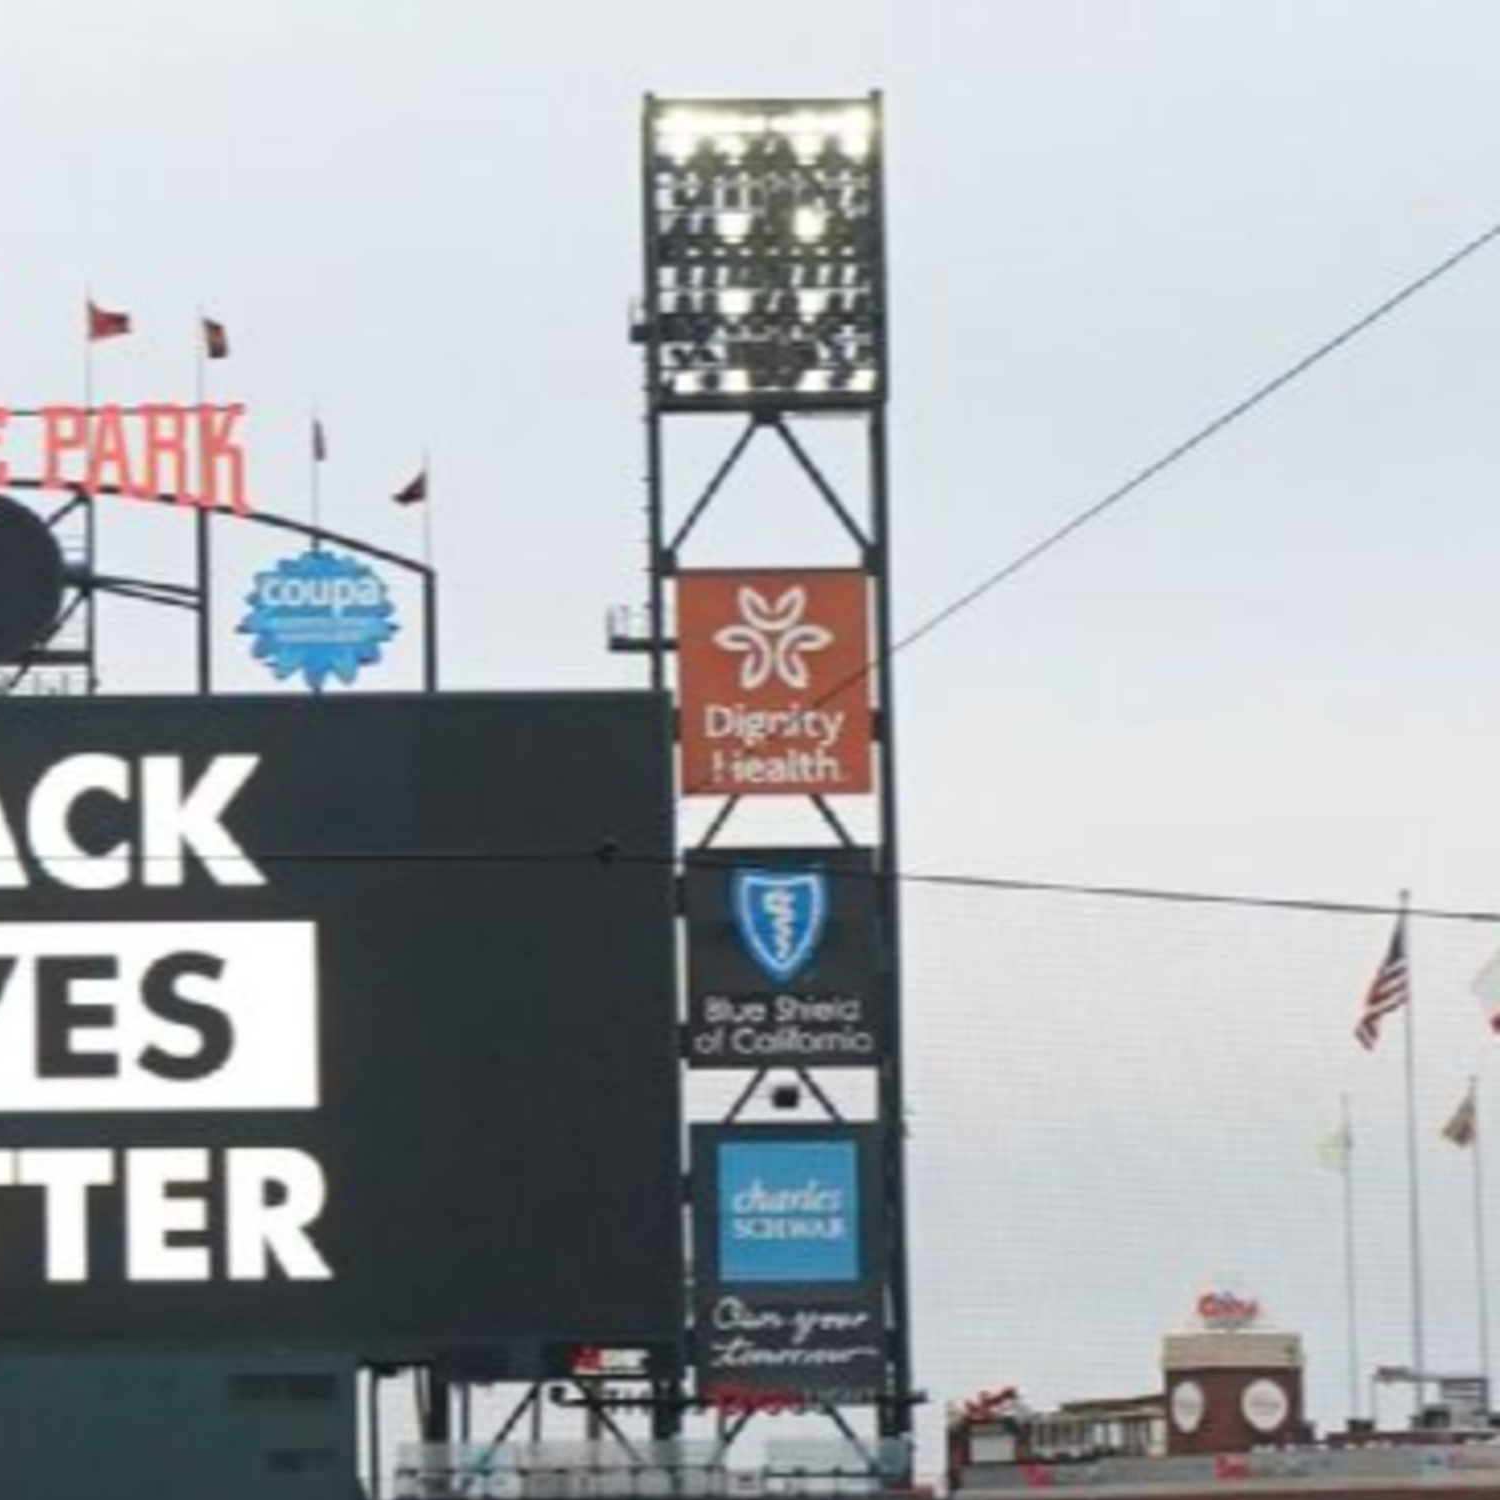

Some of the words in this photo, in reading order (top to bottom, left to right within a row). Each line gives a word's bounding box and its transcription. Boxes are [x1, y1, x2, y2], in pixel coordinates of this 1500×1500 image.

[43, 401, 248, 520] PARK
[261, 577, 381, 618] coupa
[704, 702, 846, 746] Dignity
[711, 750, 844, 784] Health
[706, 997, 767, 1023] Blue
[775, 995, 860, 1023] Shield
[695, 1027, 724, 1054] of
[731, 1026, 872, 1055] California
